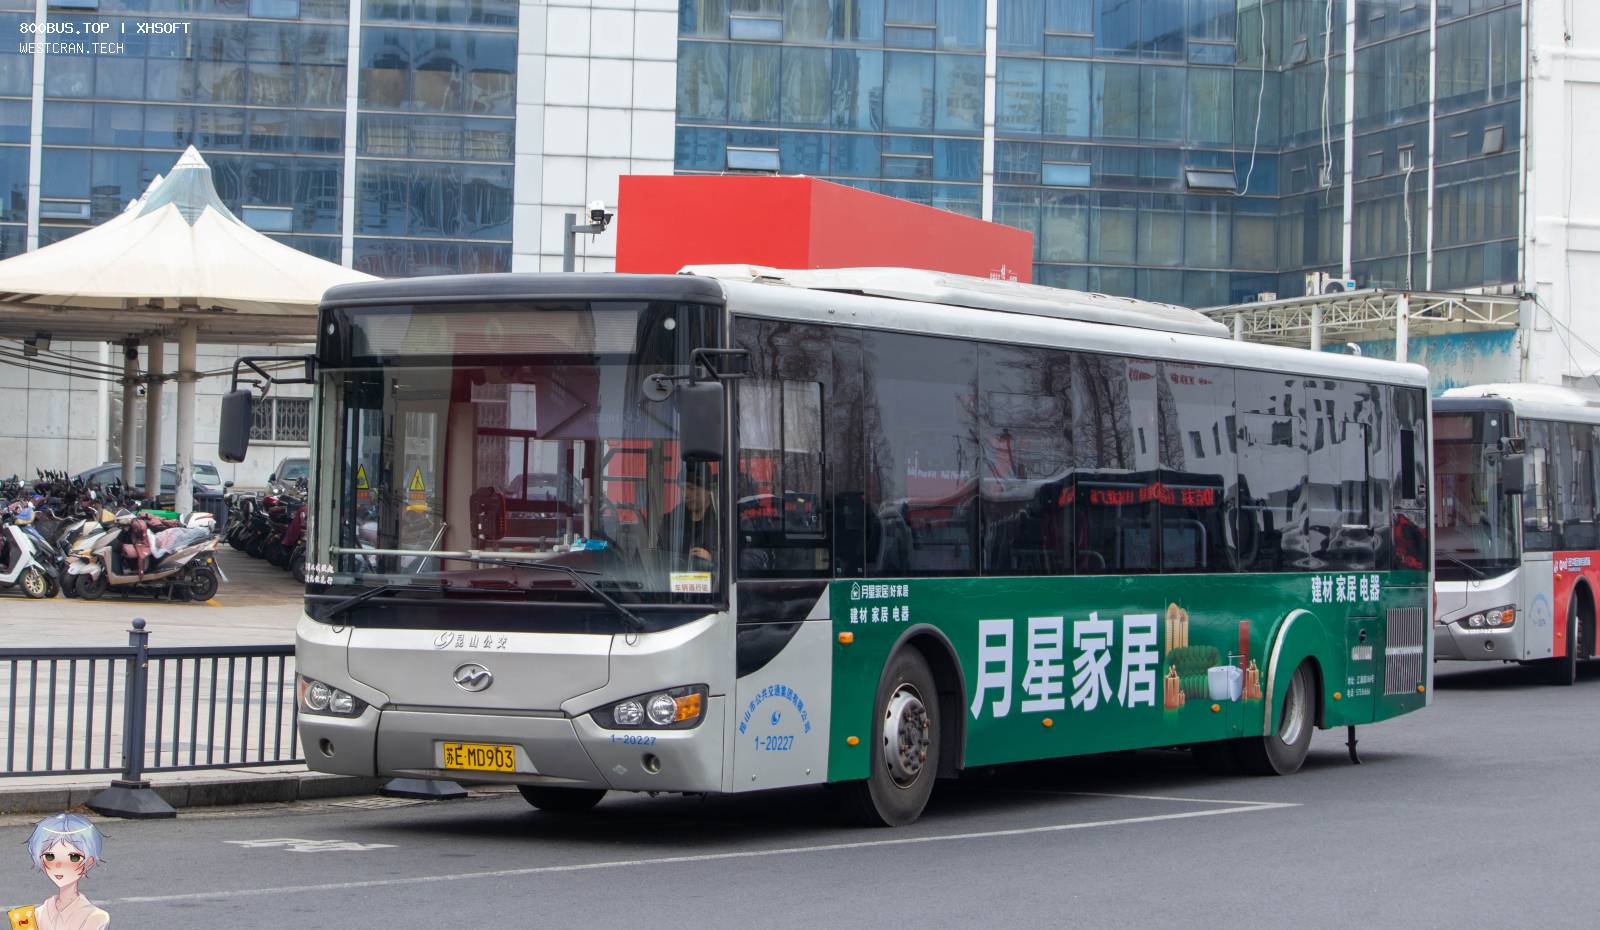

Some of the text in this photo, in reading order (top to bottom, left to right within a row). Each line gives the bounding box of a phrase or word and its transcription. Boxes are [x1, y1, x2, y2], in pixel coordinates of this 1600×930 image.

[861, 584, 909, 599] 月星家居 好家居
[1311, 574, 1380, 604] 建材 家居 电器
[850, 605, 910, 624] 建材 家居 电器
[455, 633, 508, 649] 昆山公交
[970, 611, 1159, 720] 月星家居
[738, 684, 811, 735] 昆山市公共交通集团有限公司
[610, 734, 657, 746] 1-20227
[754, 735, 795, 752] 1-20227
